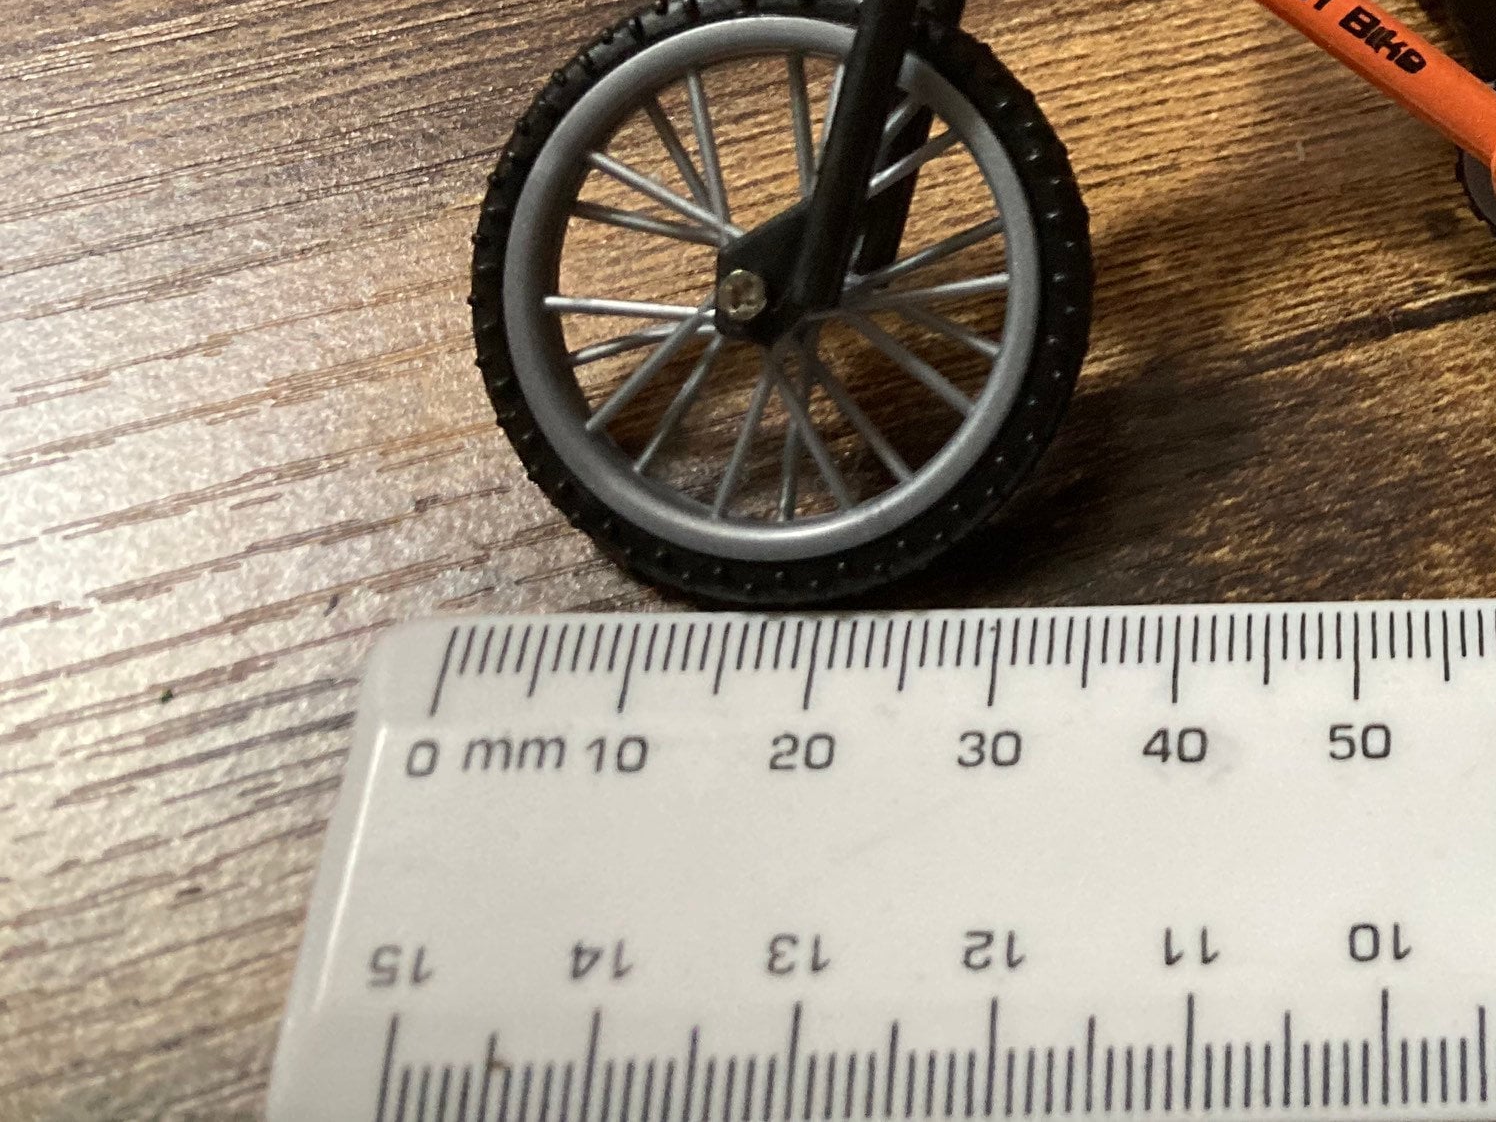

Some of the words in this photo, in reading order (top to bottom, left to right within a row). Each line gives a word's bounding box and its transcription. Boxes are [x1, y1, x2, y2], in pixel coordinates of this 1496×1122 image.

[1338, 6, 1427, 74] Bike
[405, 739, 440, 778] 0
[462, 736, 566, 772] mm
[587, 735, 649, 774] 10
[769, 732, 836, 771] 20
[957, 730, 1022, 769] 30
[1142, 727, 1209, 764] 40
[1329, 723, 1391, 762] 50
[569, 940, 633, 981] 14
[766, 933, 831, 976] 13
[961, 930, 1026, 972] 12
[1164, 926, 1220, 967] 11
[1348, 922, 1412, 963] 10
[369, 945, 432, 987] 15
